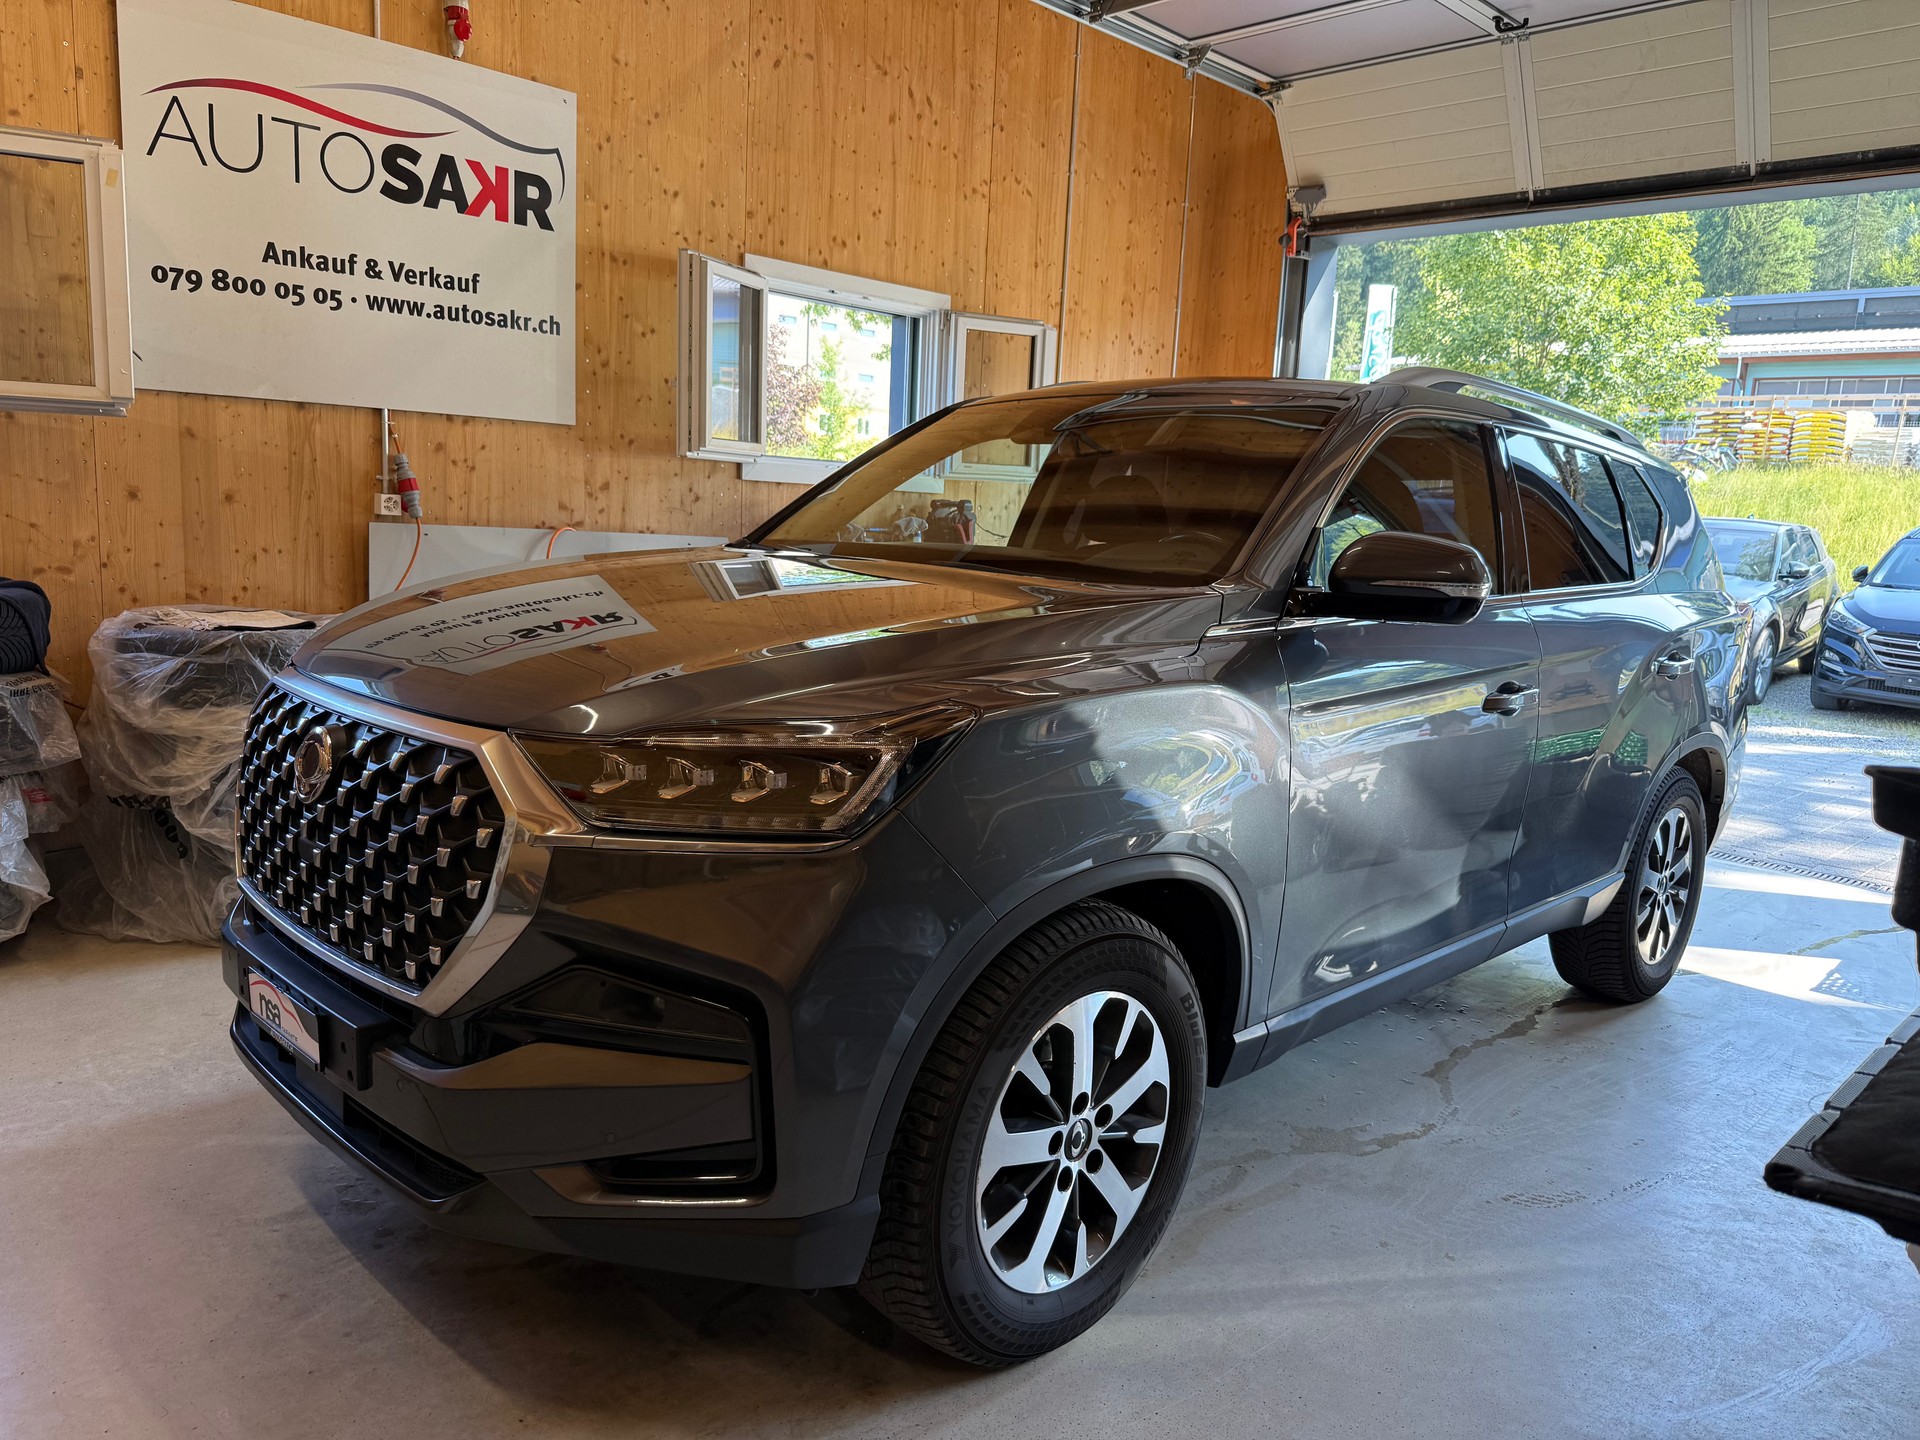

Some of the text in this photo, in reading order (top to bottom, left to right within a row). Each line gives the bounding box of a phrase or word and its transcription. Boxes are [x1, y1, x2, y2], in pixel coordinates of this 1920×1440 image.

[146, 95, 555, 232] AUTOSAKR
[151, 265, 203, 293] 079
[211, 269, 266, 296] 800
[274, 282, 306, 306] 05
[313, 288, 343, 311] 05
[365, 294, 561, 336] www.autosakr.ch
[261, 241, 481, 294] Ankauf & Verkauf
[948, 1084, 993, 1236] YOKOHAMA
